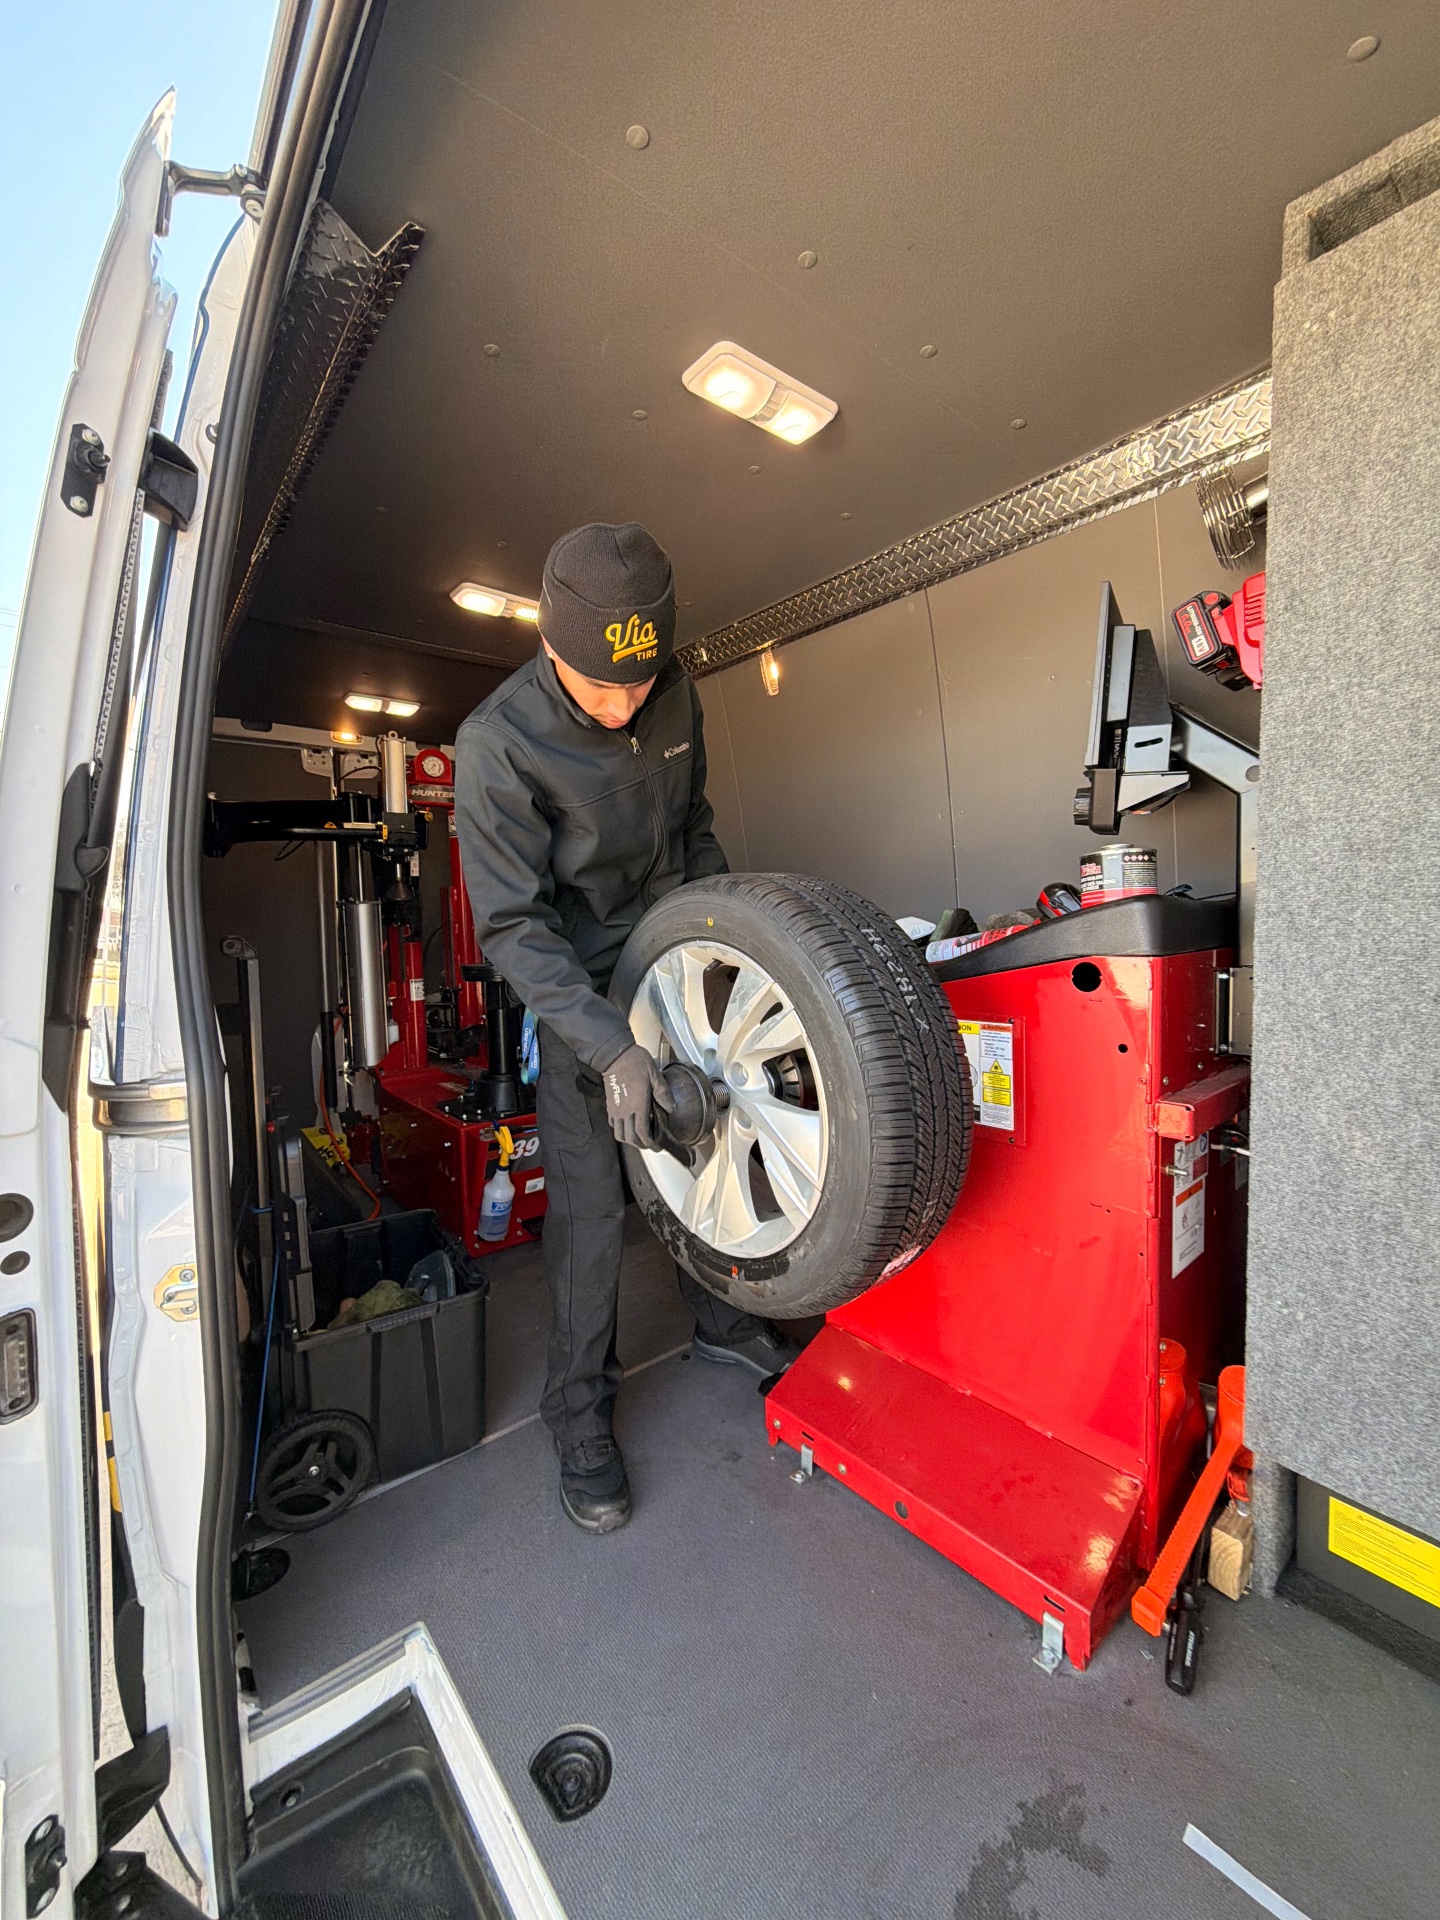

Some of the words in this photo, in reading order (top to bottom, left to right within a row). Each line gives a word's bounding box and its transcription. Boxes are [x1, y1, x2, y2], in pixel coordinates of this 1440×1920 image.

[605, 613, 657, 650] Via
[1195, 638, 1206, 653] 18V
[636, 647, 658, 661] TIRE
[669, 741, 690, 757] Columbia
[411, 788, 456, 799] HUNTER
